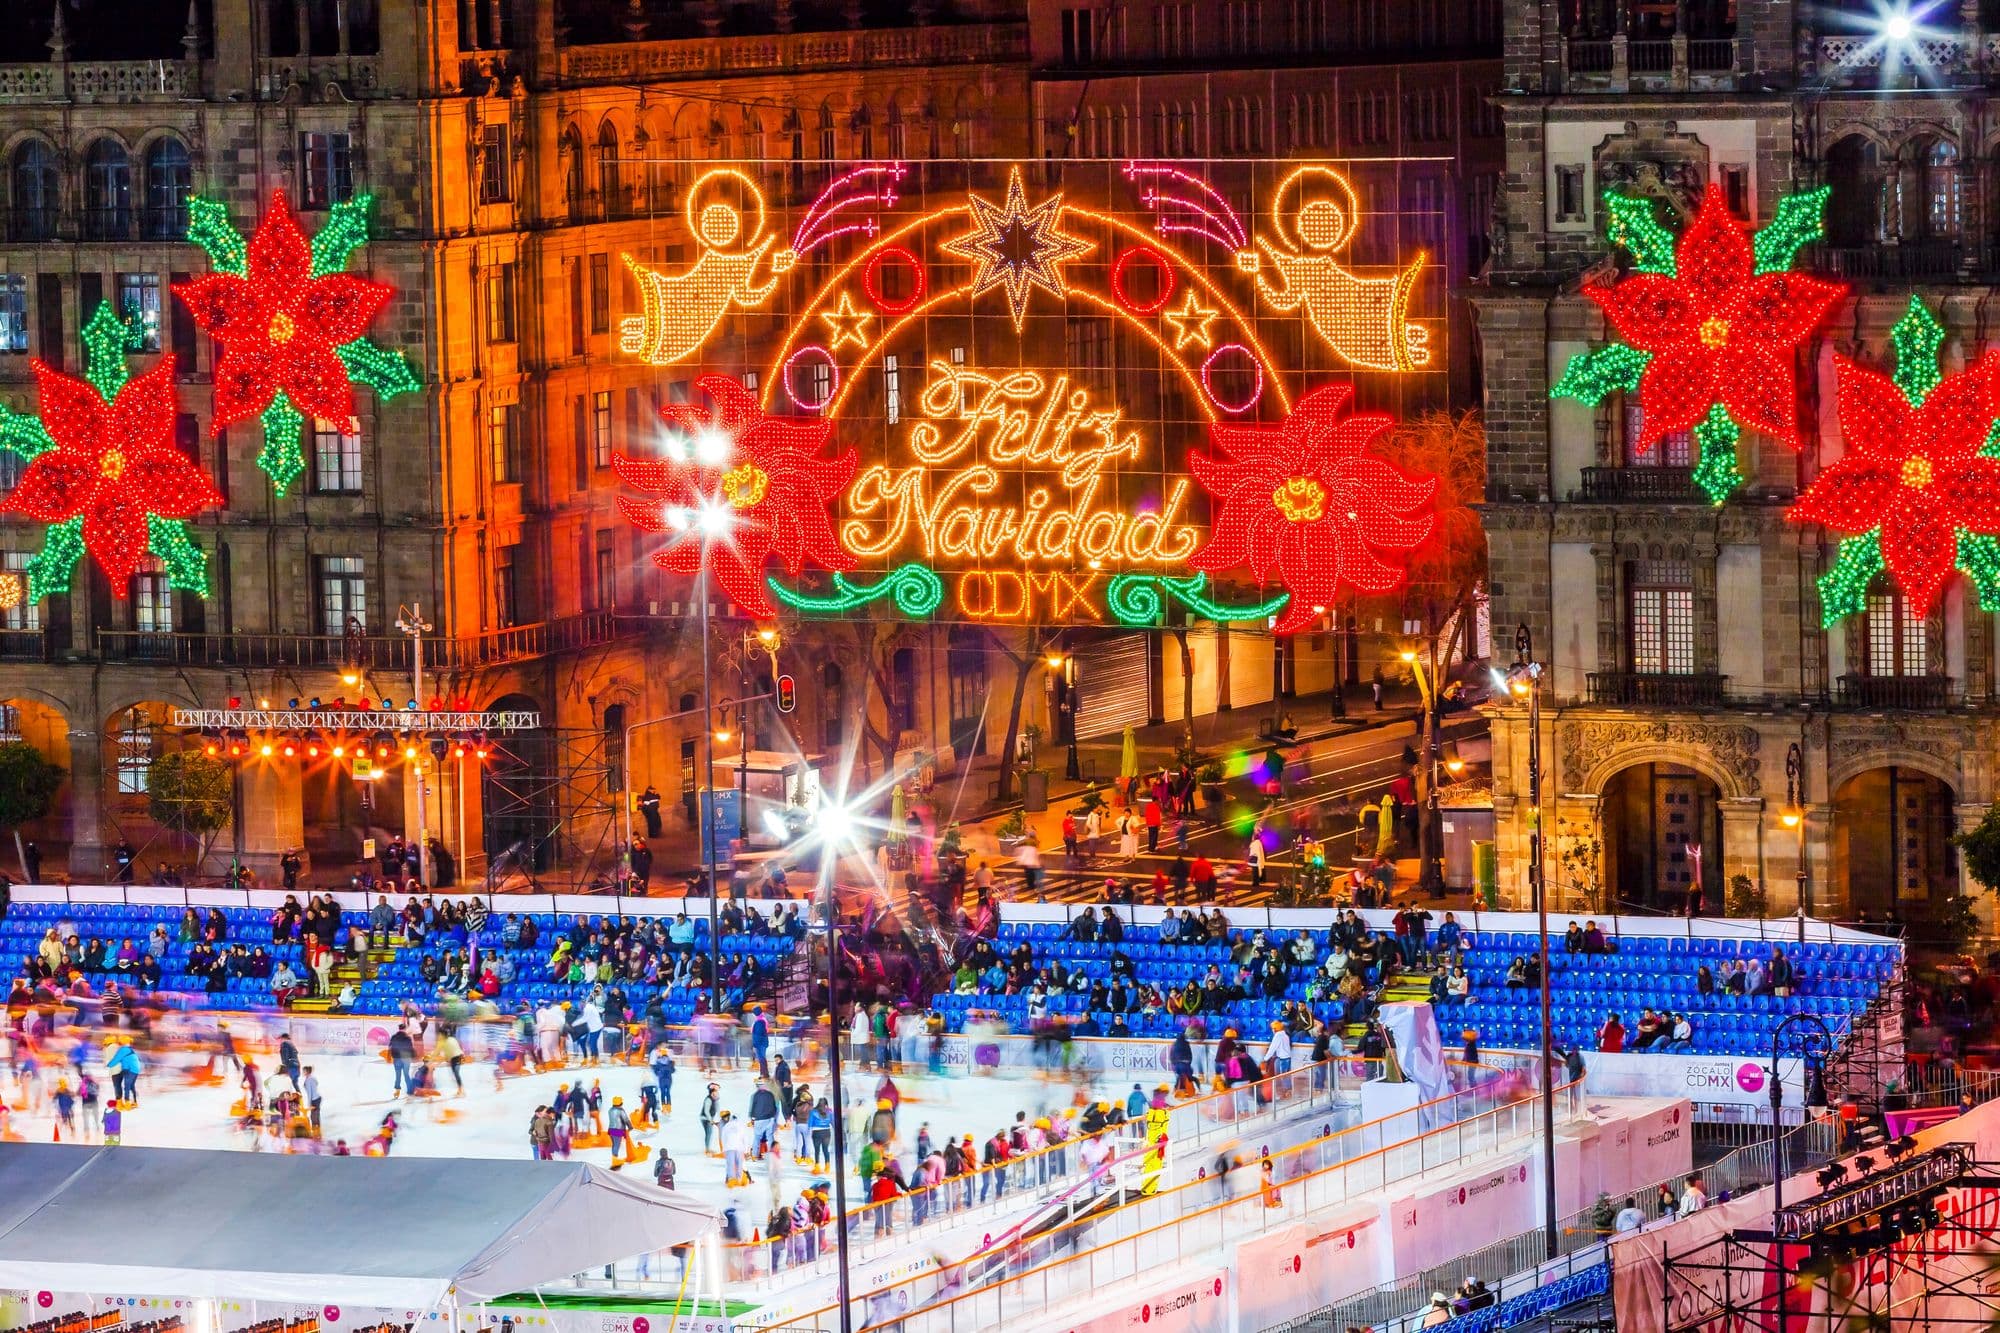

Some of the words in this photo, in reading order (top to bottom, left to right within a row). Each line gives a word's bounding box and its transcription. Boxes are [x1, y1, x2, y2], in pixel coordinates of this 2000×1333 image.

[911, 360, 1142, 488] Feliz
[842, 464, 1198, 561] Navidad
[958, 569, 1102, 619] CDMX
[712, 791, 732, 800] DMX
[1686, 1075, 1730, 1087] CDMX
[1154, 1291, 1197, 1318] #pistaCDMX
[602, 1324, 629, 1333] CDMX
